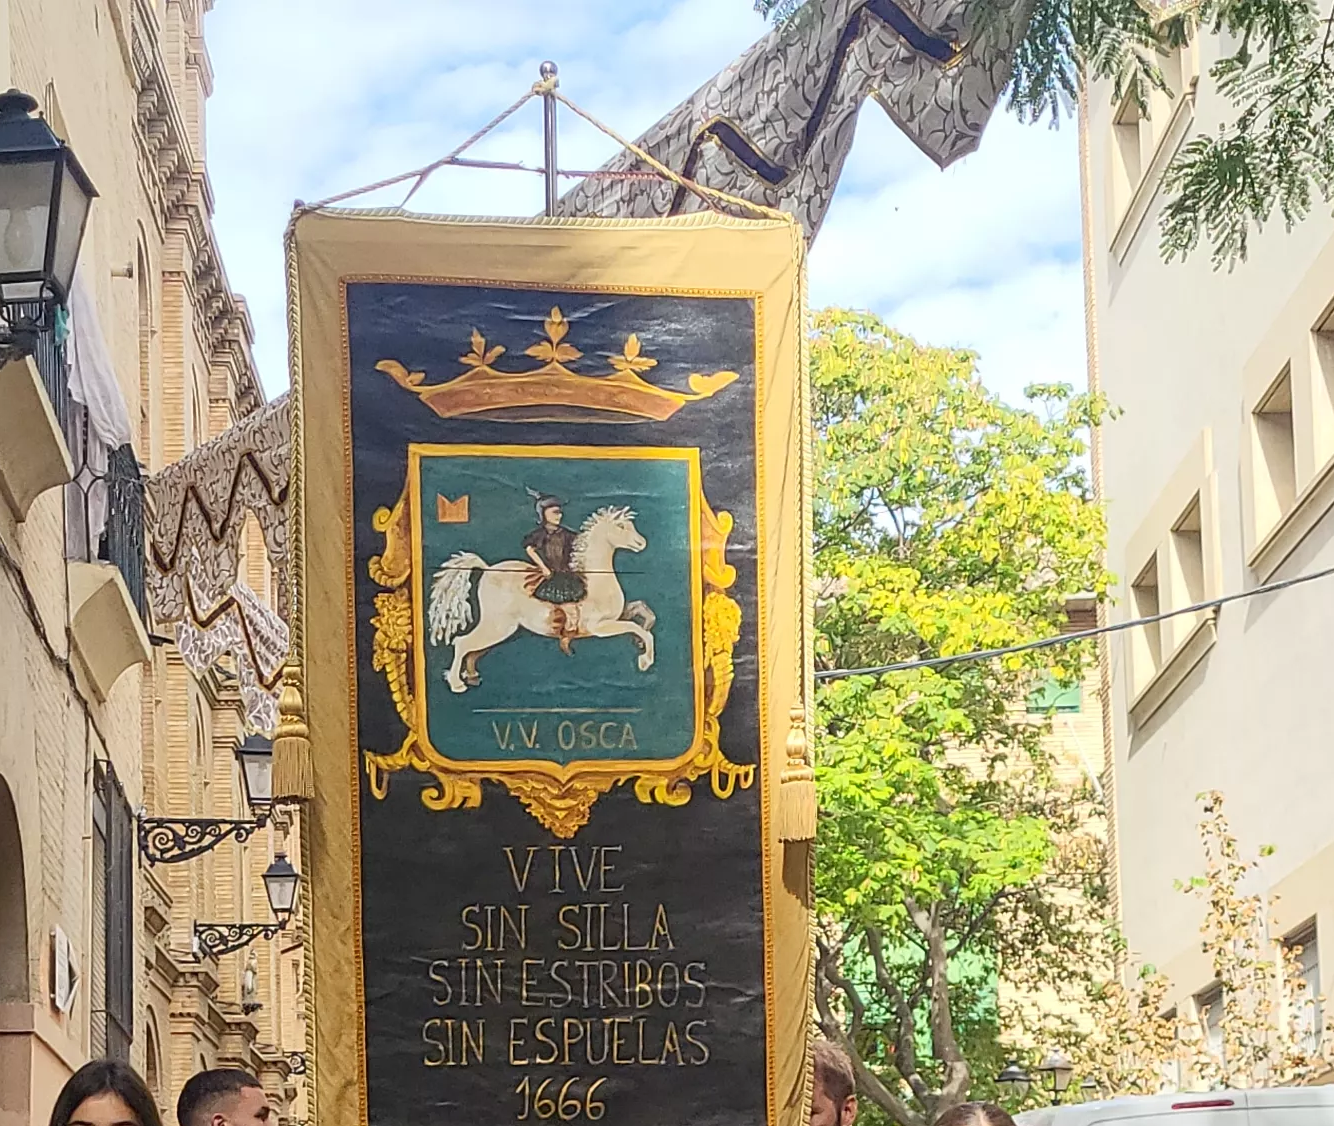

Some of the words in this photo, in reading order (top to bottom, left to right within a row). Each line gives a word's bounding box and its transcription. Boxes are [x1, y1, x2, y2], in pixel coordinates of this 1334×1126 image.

[557, 720, 638, 751] OSCA
[503, 845, 625, 893] VIVE
[460, 904, 530, 951] SIN
[558, 903, 675, 951] SILLA
[428, 958, 503, 1007] SIN
[521, 960, 706, 1009] ESTRIBOS
[422, 1019, 485, 1066] SIN
[508, 1016, 710, 1066] ESPUELAS
[515, 1076, 608, 1121] 1666
